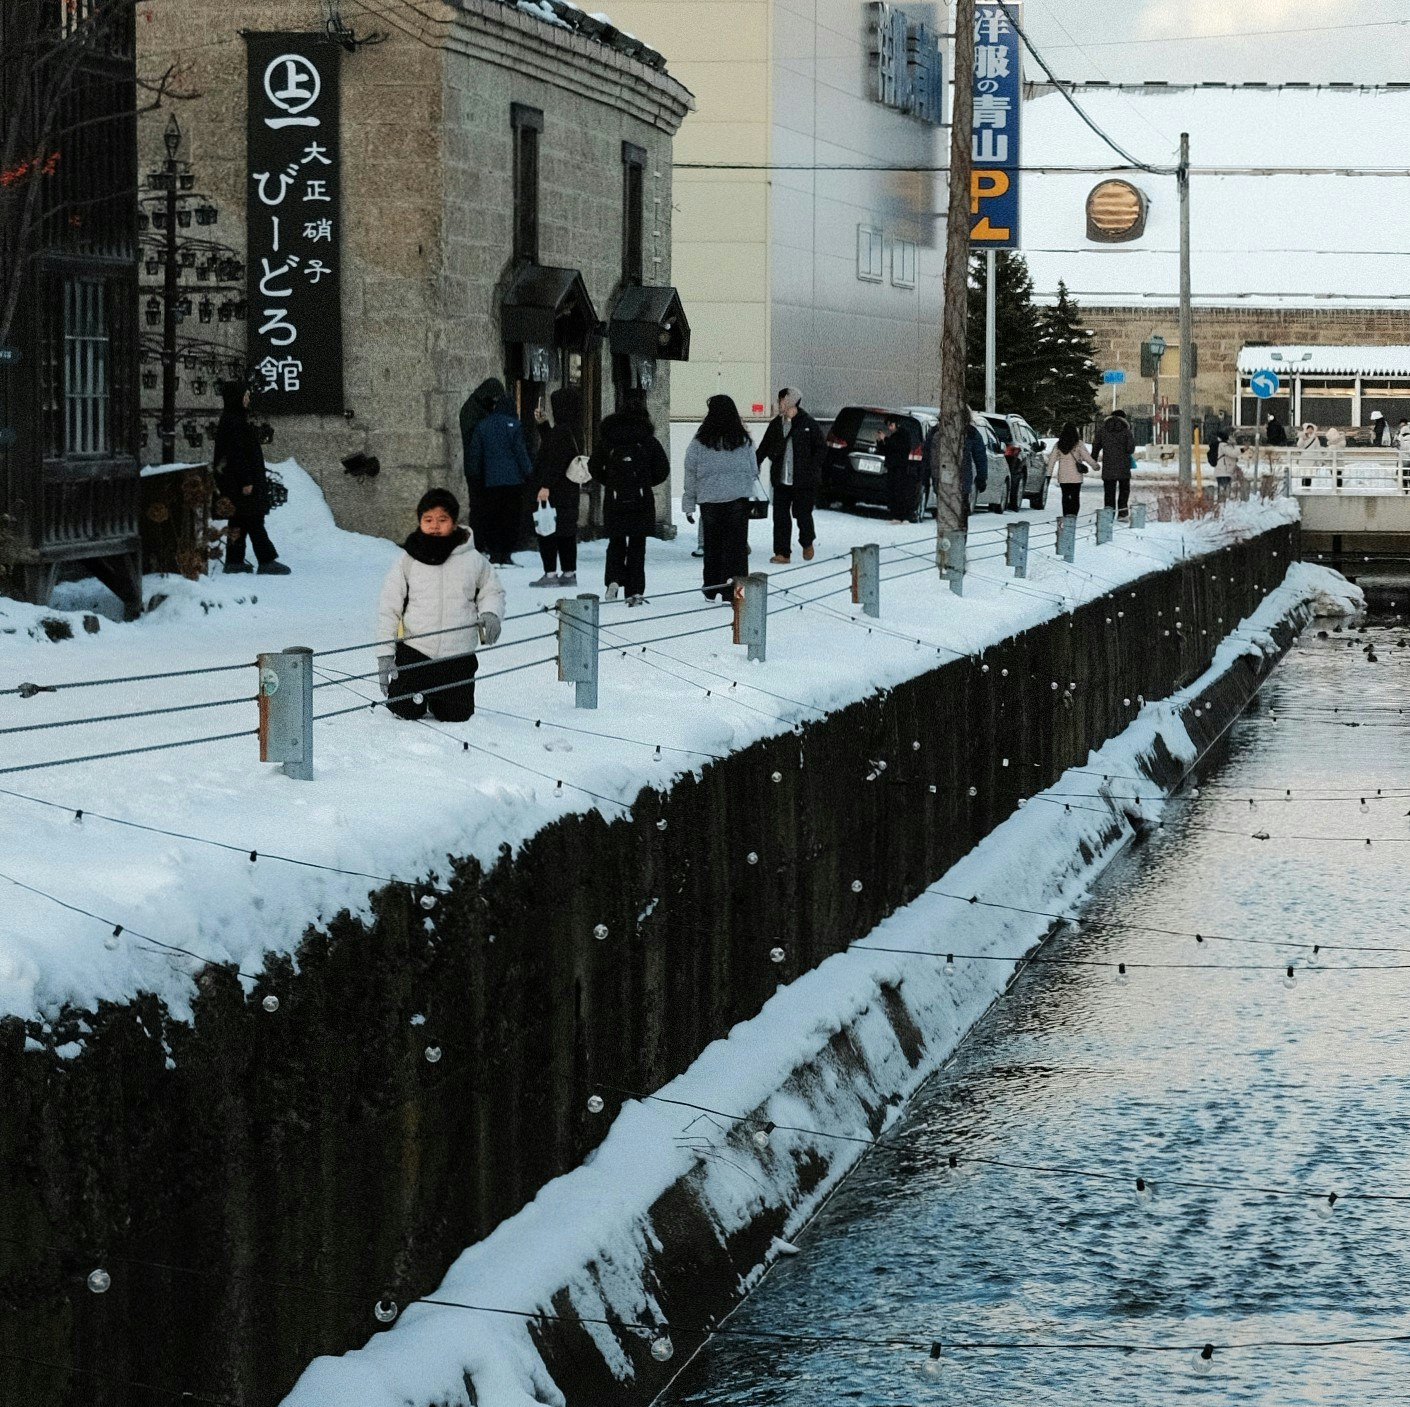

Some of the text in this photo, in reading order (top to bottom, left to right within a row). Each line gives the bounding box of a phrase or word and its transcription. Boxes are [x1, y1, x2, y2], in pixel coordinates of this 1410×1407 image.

[972, 8, 1012, 162] 洋服の青山
[300, 140, 333, 284] 大正硝子
[969, 169, 1011, 215] P
[252, 163, 304, 394] びーどろ館
